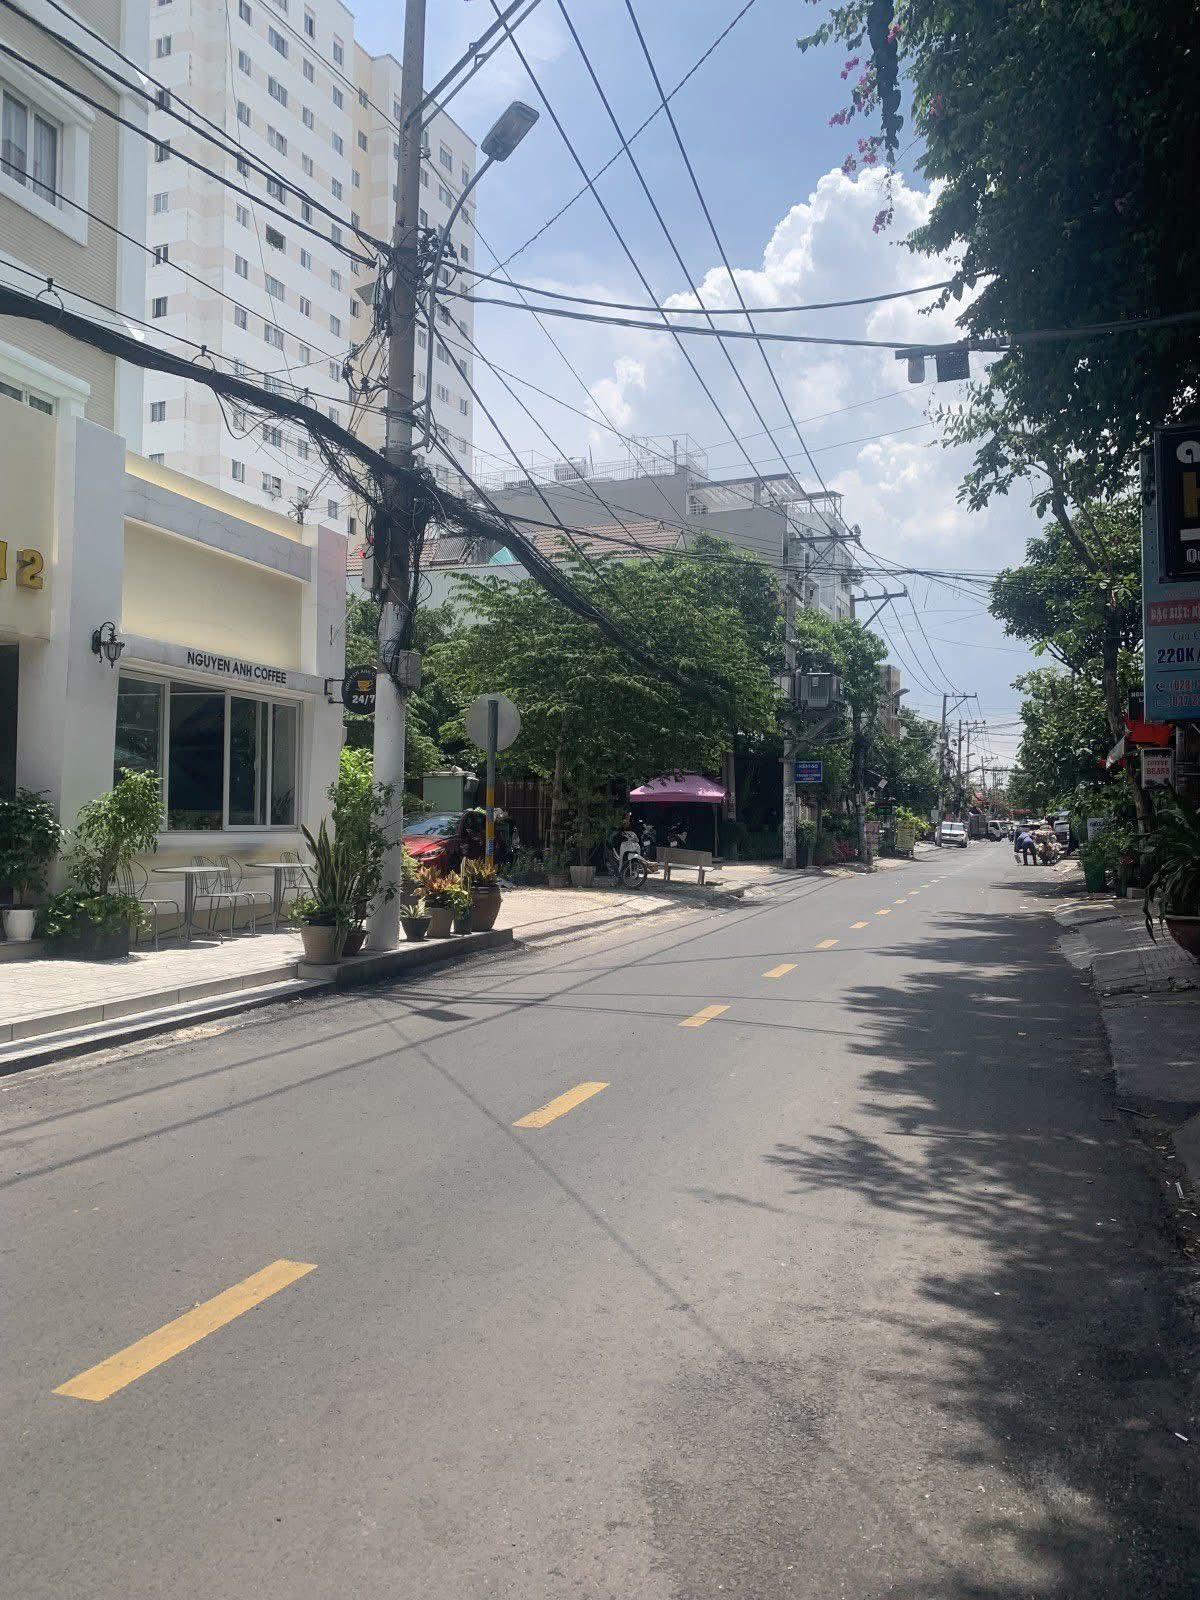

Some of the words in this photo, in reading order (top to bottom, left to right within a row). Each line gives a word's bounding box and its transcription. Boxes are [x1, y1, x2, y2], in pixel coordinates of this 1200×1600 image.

[187, 651, 230, 672] NGUYEN
[232, 662, 252, 677] ANH
[254, 666, 287, 684] COFFEE
[352, 694, 376, 706] 24/7
